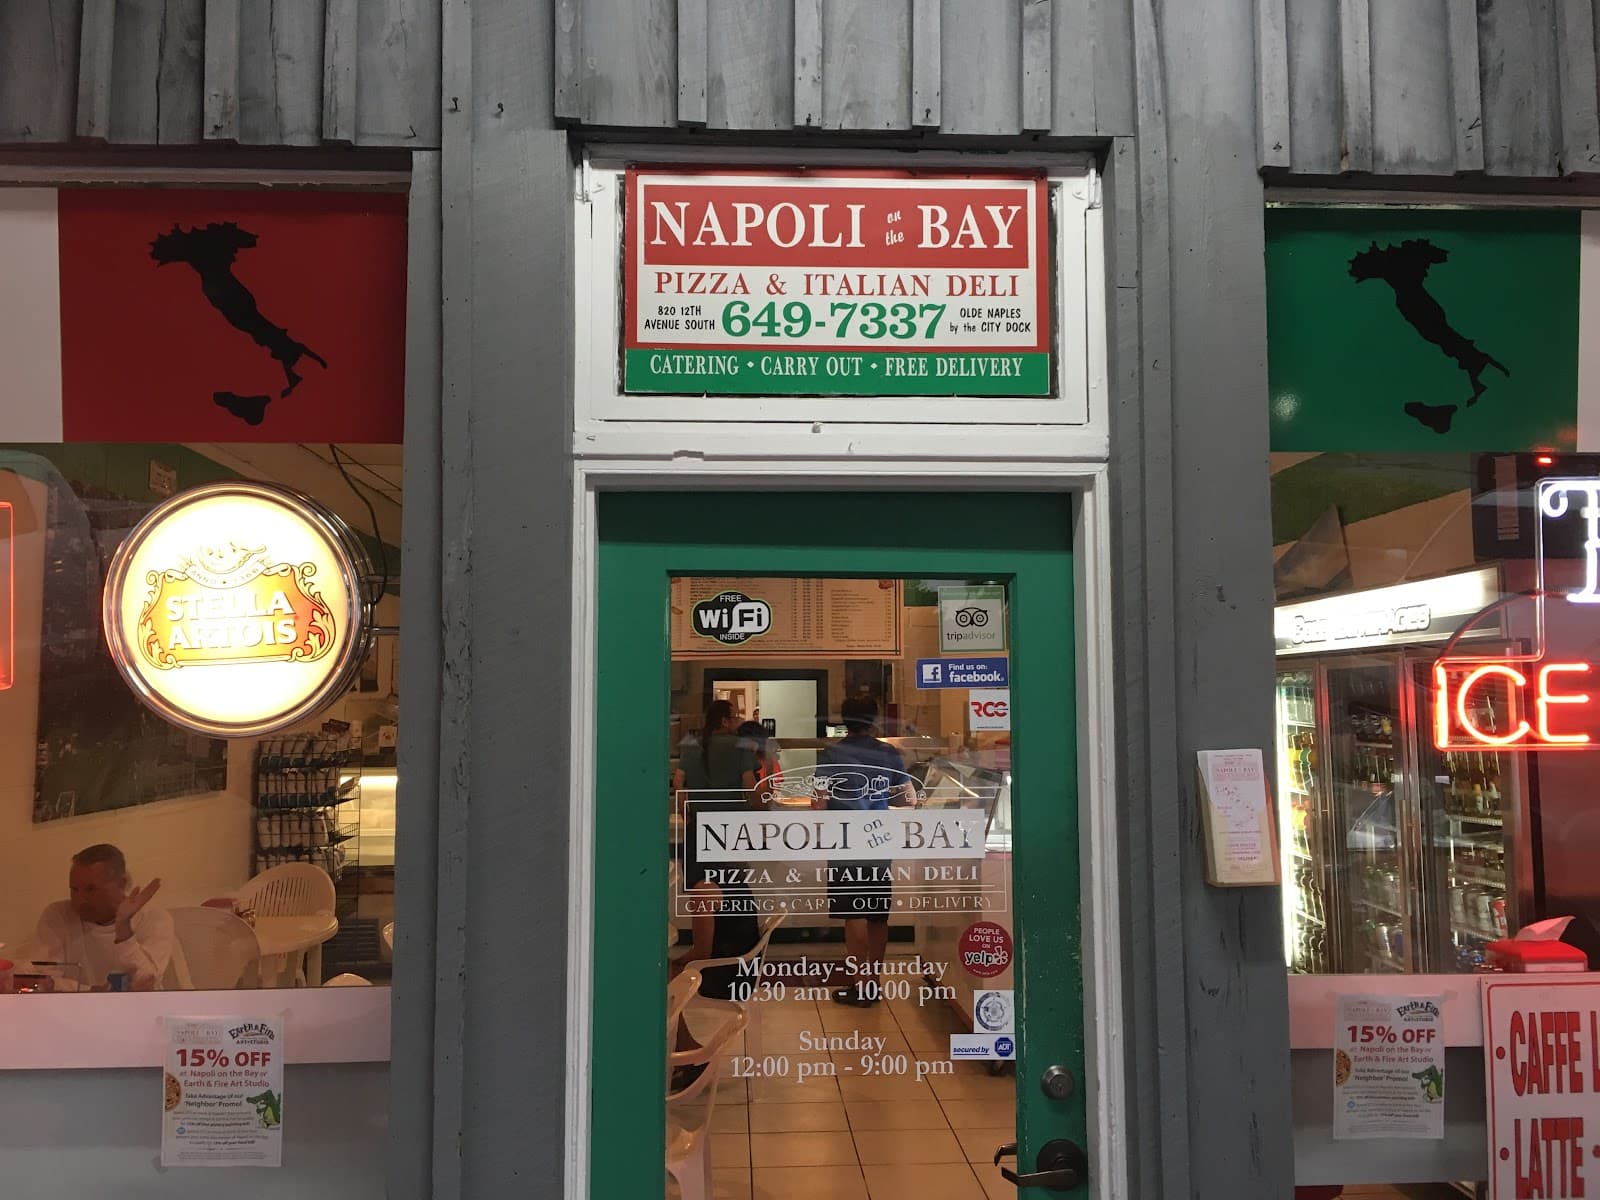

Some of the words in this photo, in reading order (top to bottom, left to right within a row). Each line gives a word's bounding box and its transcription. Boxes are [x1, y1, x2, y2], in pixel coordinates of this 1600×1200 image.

[650, 201, 865, 248] NAPOLI
[887, 211, 901, 224] on
[917, 205, 1021, 249] BAY
[885, 229, 904, 246] the
[654, 272, 750, 295] PIZZA
[766, 274, 786, 296] &
[804, 274, 930, 297] ITALIAN
[946, 275, 1019, 297] DELI
[657, 305, 677, 316] 820
[681, 305, 701, 316] 12TH
[722, 300, 947, 339] 649-7337
[959, 308, 984, 319] OLDE
[987, 308, 1021, 319] NAPLES
[644, 319, 680, 331] AVENUE
[684, 319, 715, 331] SOUTH
[949, 322, 960, 334] by
[963, 322, 977, 333] the
[981, 322, 1002, 333] CITY
[1005, 322, 1031, 333] DOCK
[650, 355, 739, 376] CATERING
[761, 355, 819, 376] CARRY
[826, 355, 862, 376] OUT
[885, 357, 928, 377] FREE
[935, 358, 1023, 377] DELIVERY
[166, 591, 296, 621] STELLA
[169, 619, 298, 650] ARTOIS
[947, 631, 995, 642] tripadvisor
[1436, 663, 1590, 748] ICE
[863, 818, 884, 833] on
[902, 819, 980, 850] BAY
[702, 822, 850, 851] NAPOLI
[866, 830, 893, 849] the
[704, 869, 773, 885] PIZZA
[785, 868, 801, 883] &
[816, 866, 911, 882] ITALIAN
[925, 866, 978, 882] DELI
[685, 899, 774, 912] CATERING
[852, 898, 892, 910] OUT
[969, 934, 991, 943] LOVE
[993, 935, 1004, 944] US
[965, 950, 994, 967] yelp
[736, 955, 949, 983] Monday-Saturday
[727, 981, 785, 1002] 10:30
[794, 986, 830, 1001] am
[855, 979, 910, 1001] 10:00
[918, 984, 957, 1006] pm
[799, 1030, 886, 1056] Sunday
[1347, 1026, 1397, 1044] 15%
[1402, 1028, 1436, 1044] OFF
[981, 1046, 990, 1054] by
[998, 1043, 1011, 1051] ADT
[1360, 1046, 1384, 1054] Napoli
[1411, 1046, 1424, 1054] Bay
[1510, 1010, 1583, 1097] CAFFE
[176, 1049, 230, 1068] 15%
[234, 1052, 271, 1067] OFF
[190, 1070, 216, 1078] Napoli
[229, 1069, 243, 1077] the
[244, 1069, 259, 1078] Bay
[730, 1056, 789, 1078] 12:00
[796, 1061, 836, 1082] pm
[860, 1055, 907, 1076] 9:00
[914, 1060, 954, 1081] pm
[244, 1080, 270, 1088] Studio
[1514, 1117, 1584, 1200] LATTE
